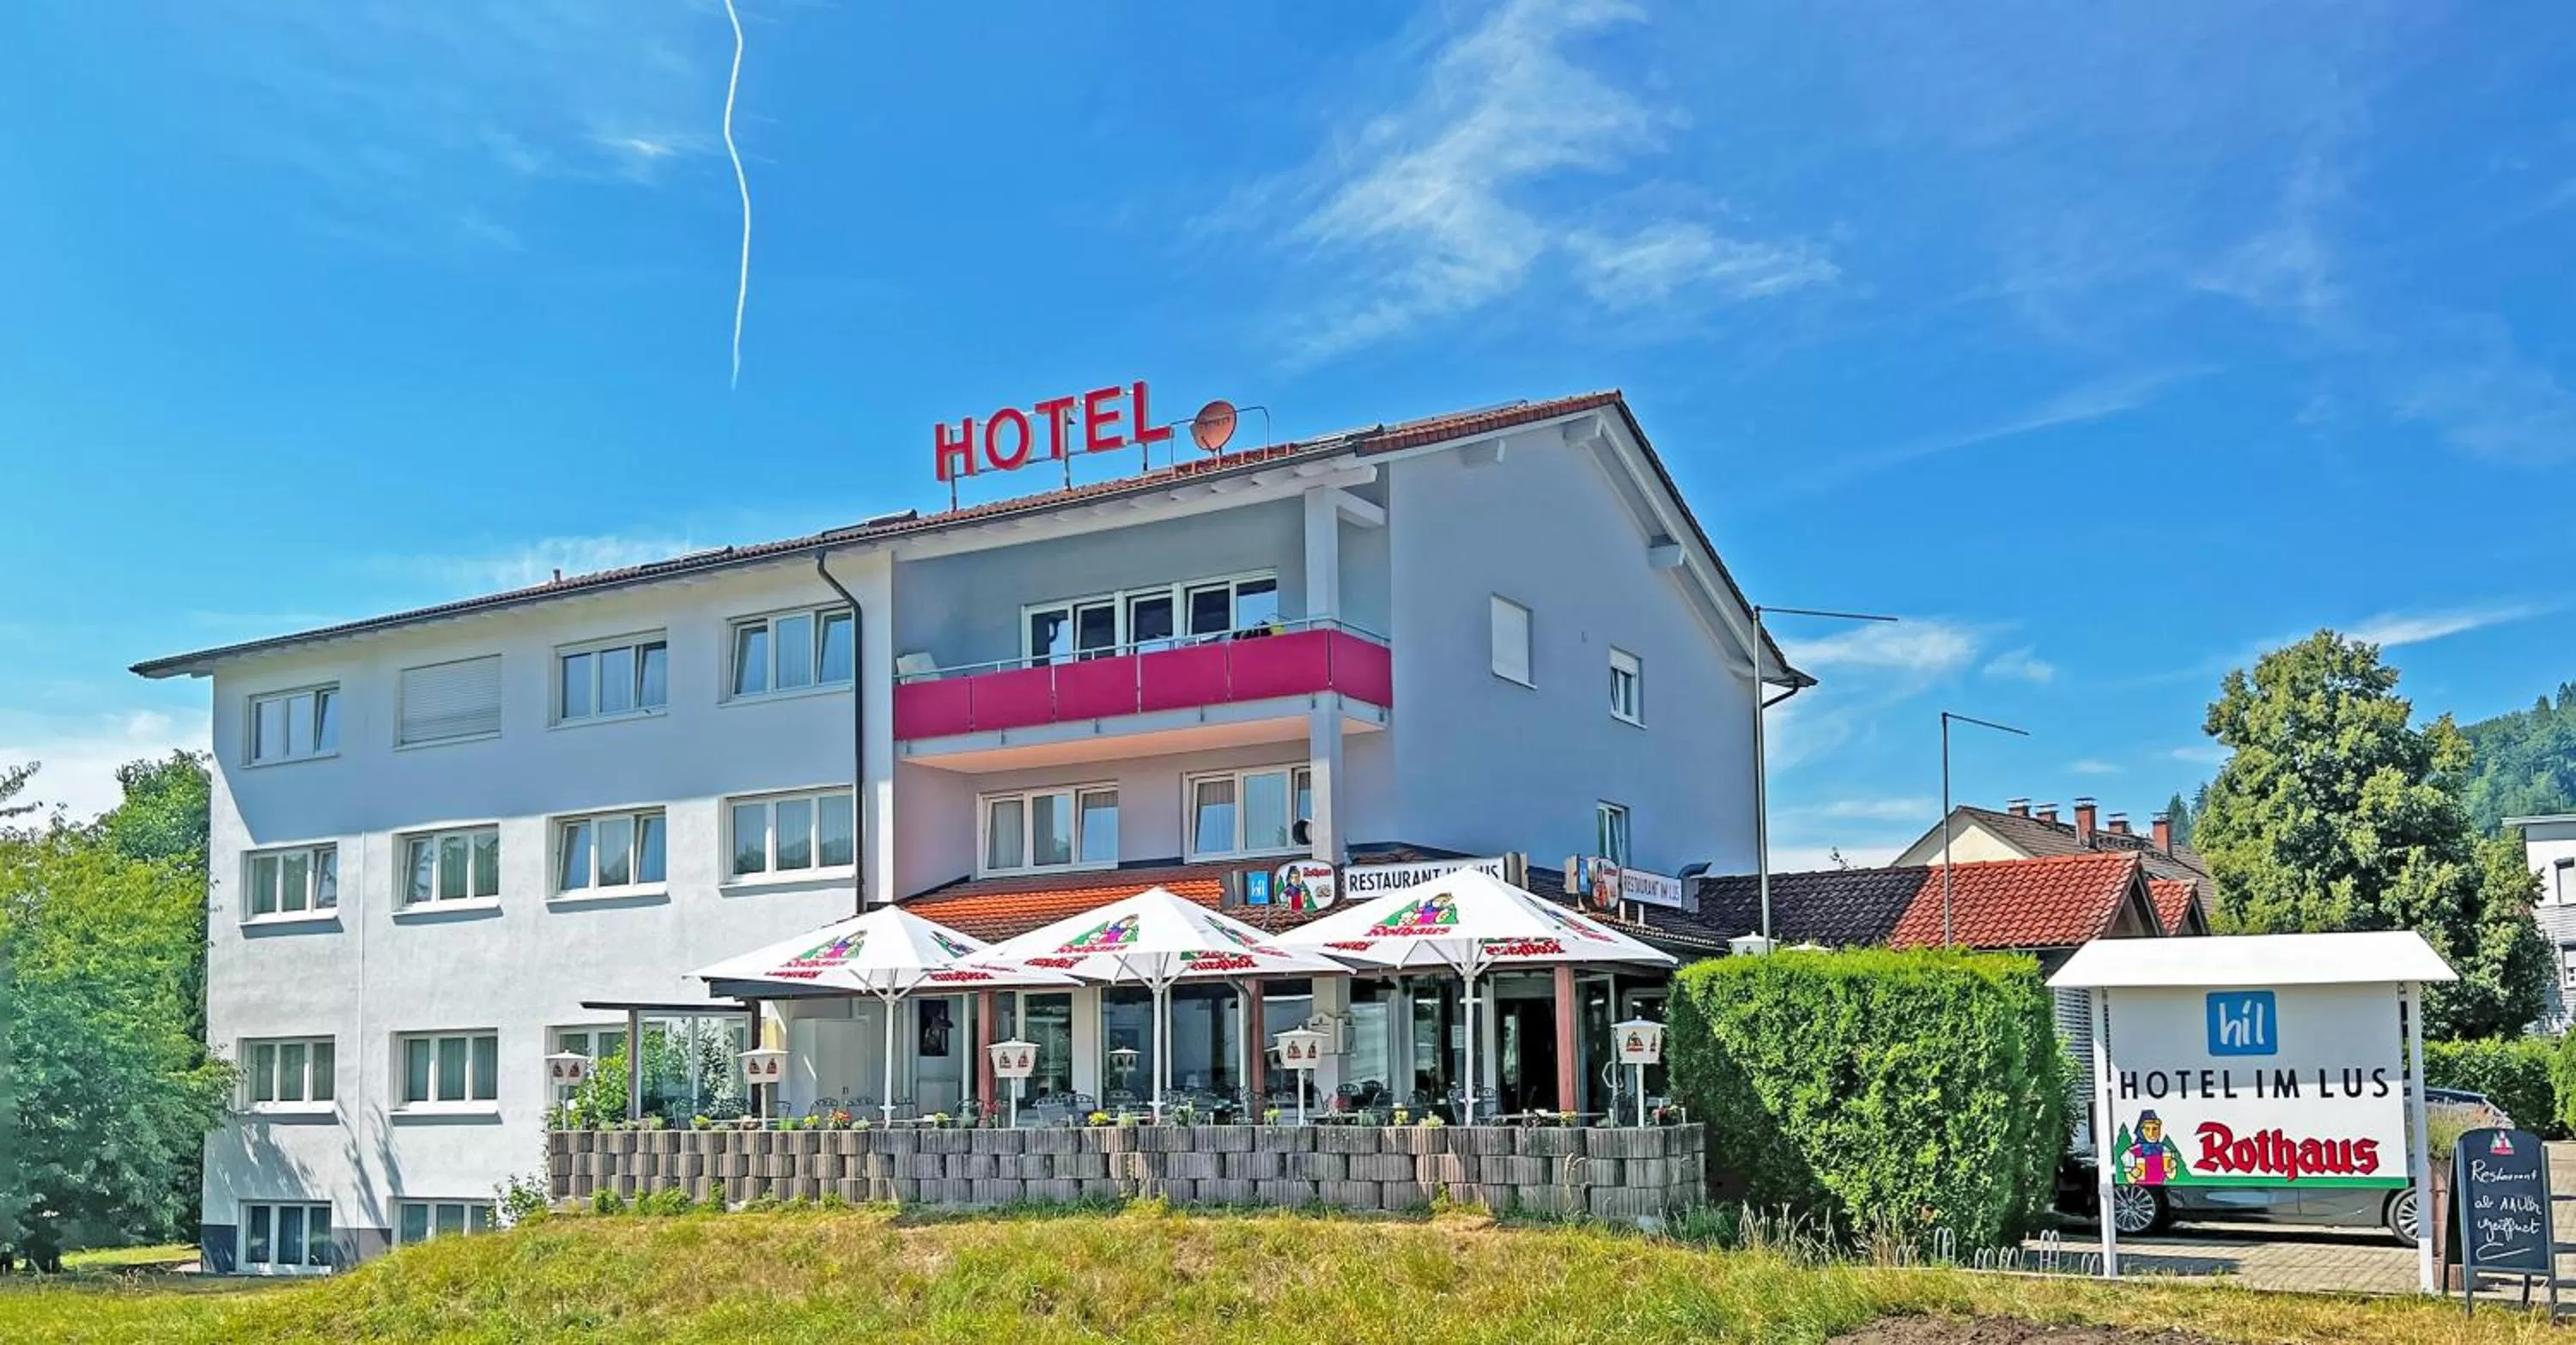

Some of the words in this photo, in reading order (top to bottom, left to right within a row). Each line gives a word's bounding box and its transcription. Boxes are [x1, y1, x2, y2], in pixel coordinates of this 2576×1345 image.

[934, 380, 1173, 482] HOTEL
[2219, 999, 2267, 1049] hil
[2119, 1070, 2237, 1100] HOTEL
[2256, 1069, 2300, 1099] IM
[2319, 1068, 2390, 1099] LUS
[2193, 1121, 2380, 1182] Rothaus
[2474, 1196, 2494, 1209] ab
